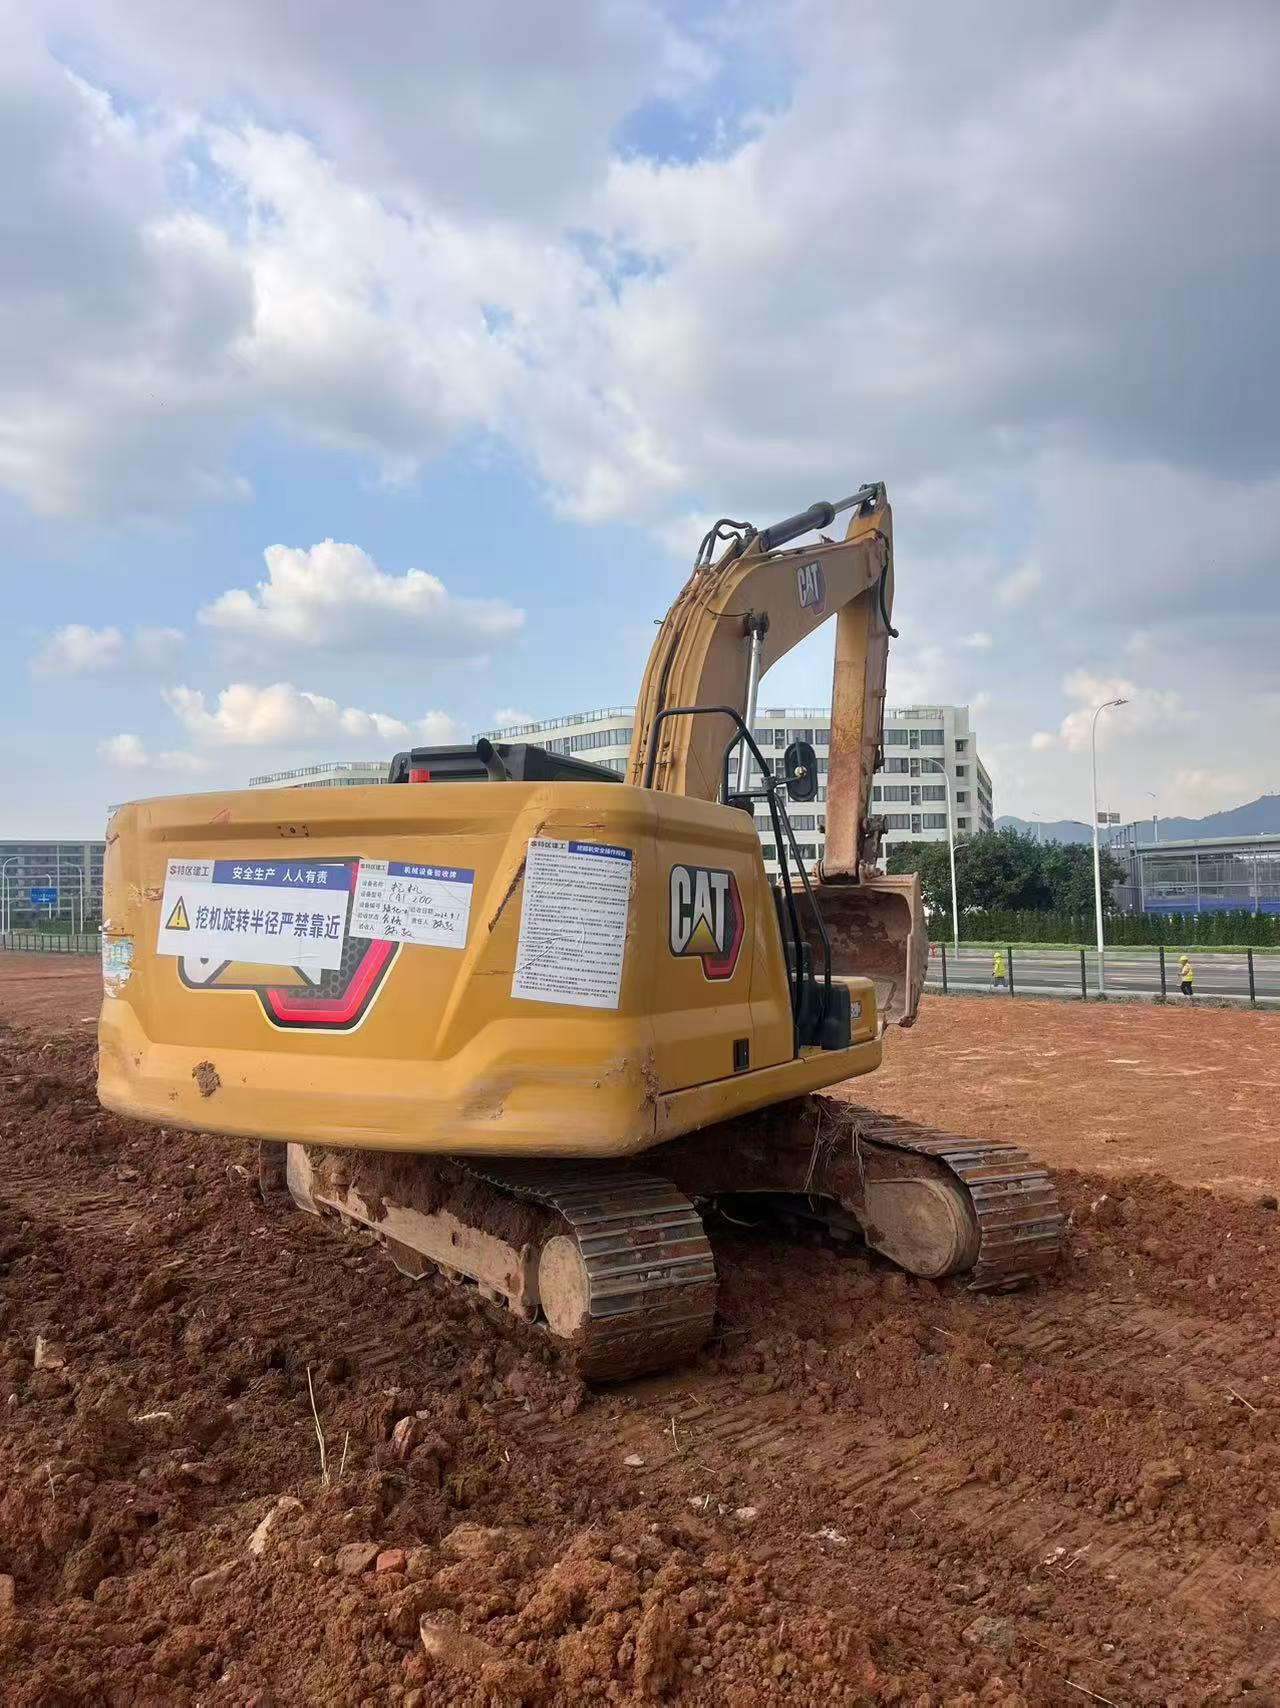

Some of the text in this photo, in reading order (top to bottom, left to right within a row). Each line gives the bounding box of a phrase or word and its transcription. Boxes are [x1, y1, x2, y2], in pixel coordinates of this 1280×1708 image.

[797, 563, 819, 608] CAT
[232, 866, 328, 884] 安全生产 人人有责
[404, 866, 457, 878] 机械设备验收牌
[361, 879, 384, 887] 设备名称
[360, 890, 382, 898] 设备型号
[359, 901, 380, 909] 设备编号
[670, 866, 729, 953] CAT
[195, 905, 341, 940] 挖机旋转半径严禁靠近
